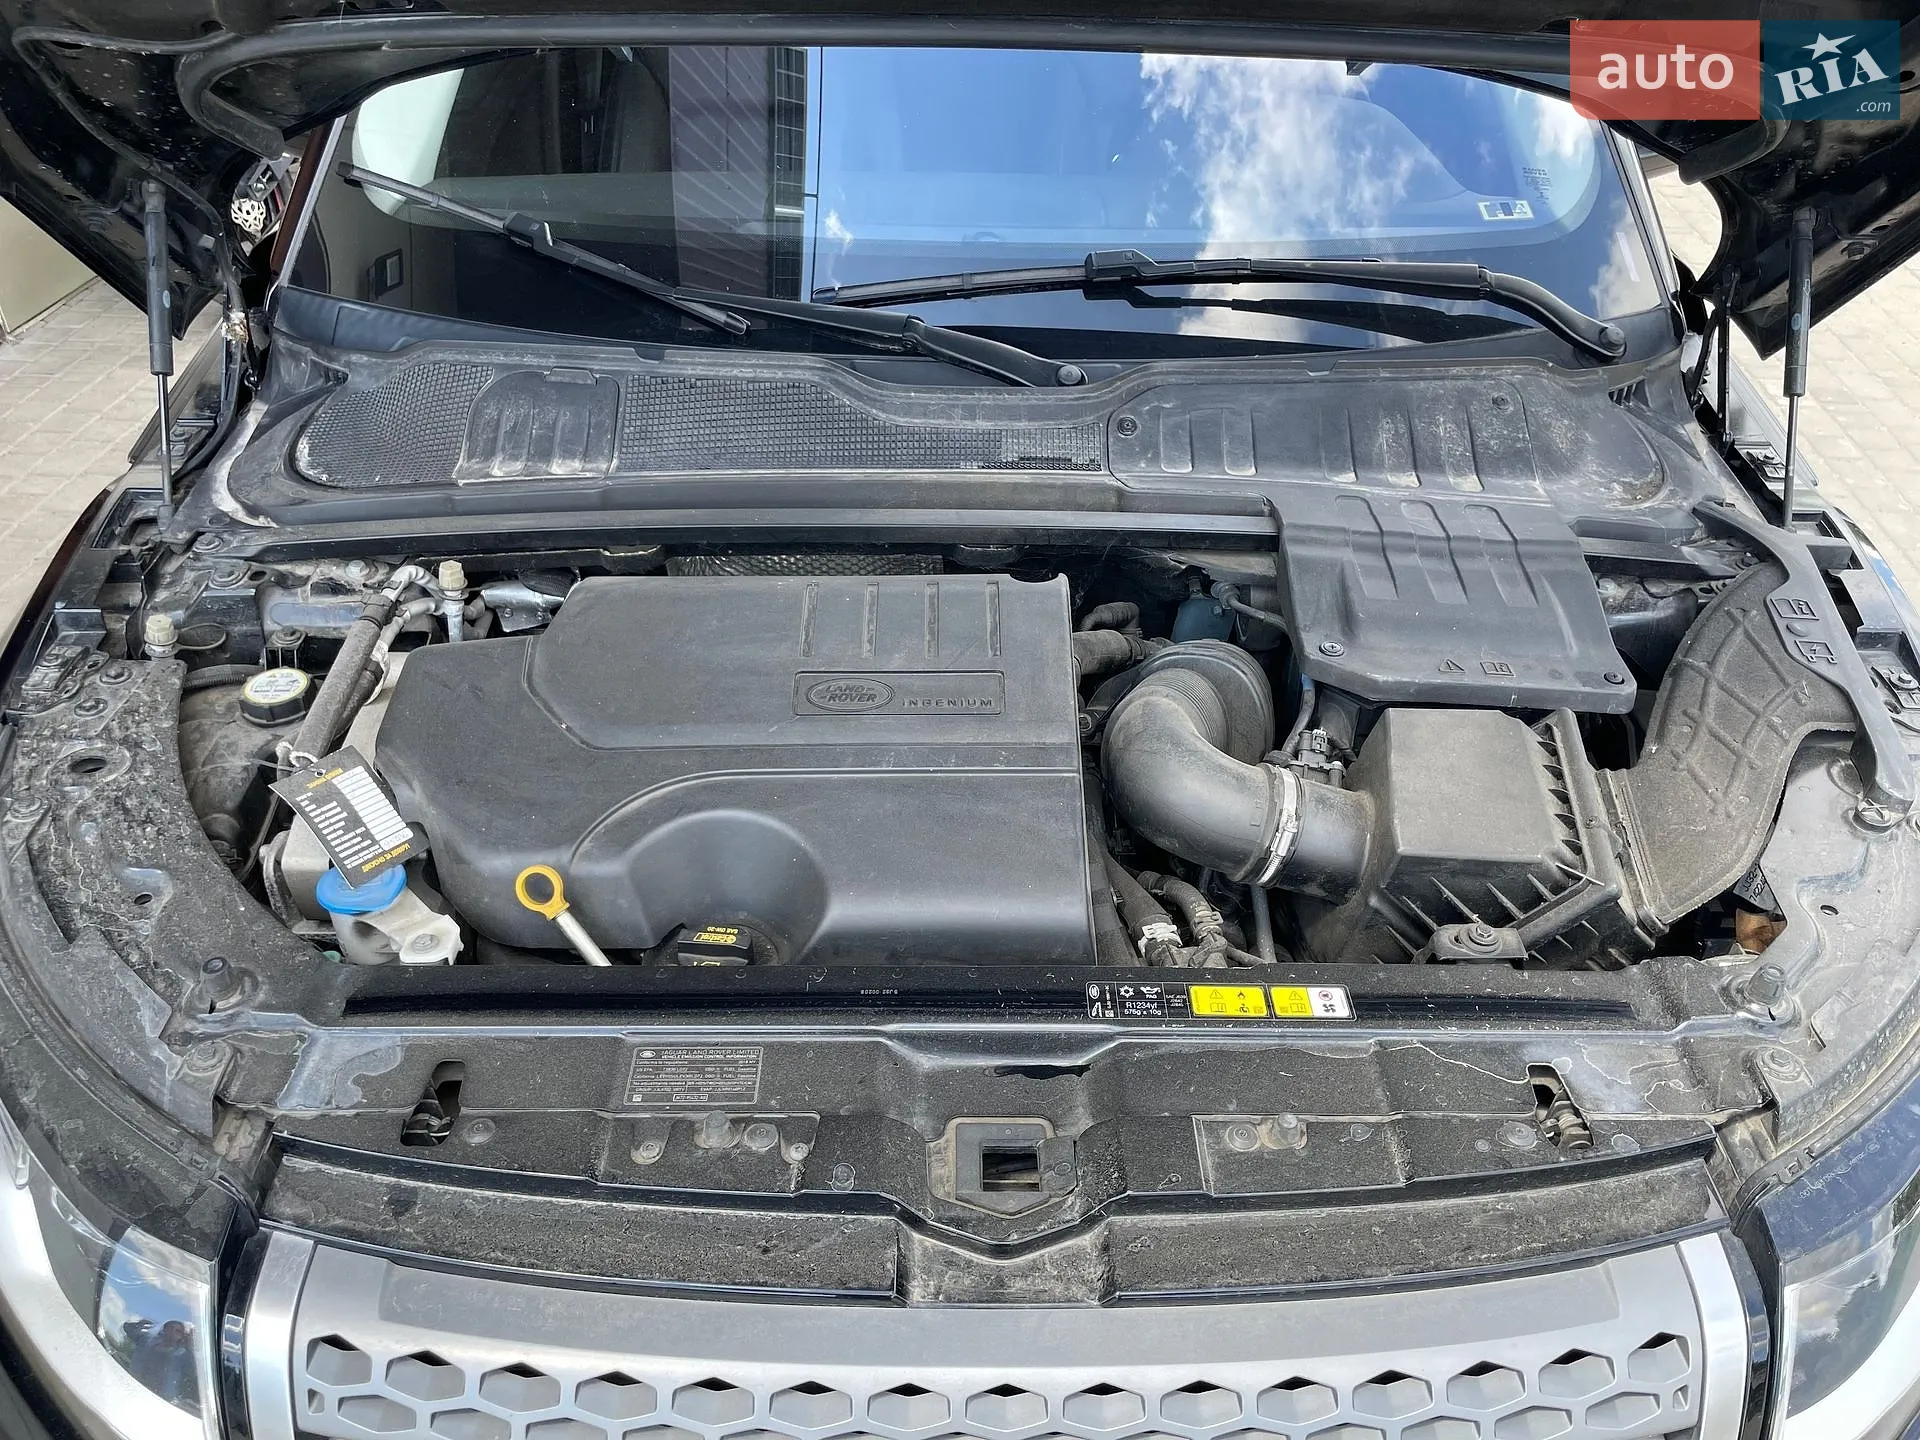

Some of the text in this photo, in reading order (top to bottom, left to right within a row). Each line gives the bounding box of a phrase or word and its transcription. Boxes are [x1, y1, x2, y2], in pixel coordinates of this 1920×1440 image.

[825, 684, 867, 693] LAND
[828, 693, 877, 703] ROVER
[902, 698, 993, 708] INGENIUM
[1125, 1001, 1158, 1010] R1234yf
